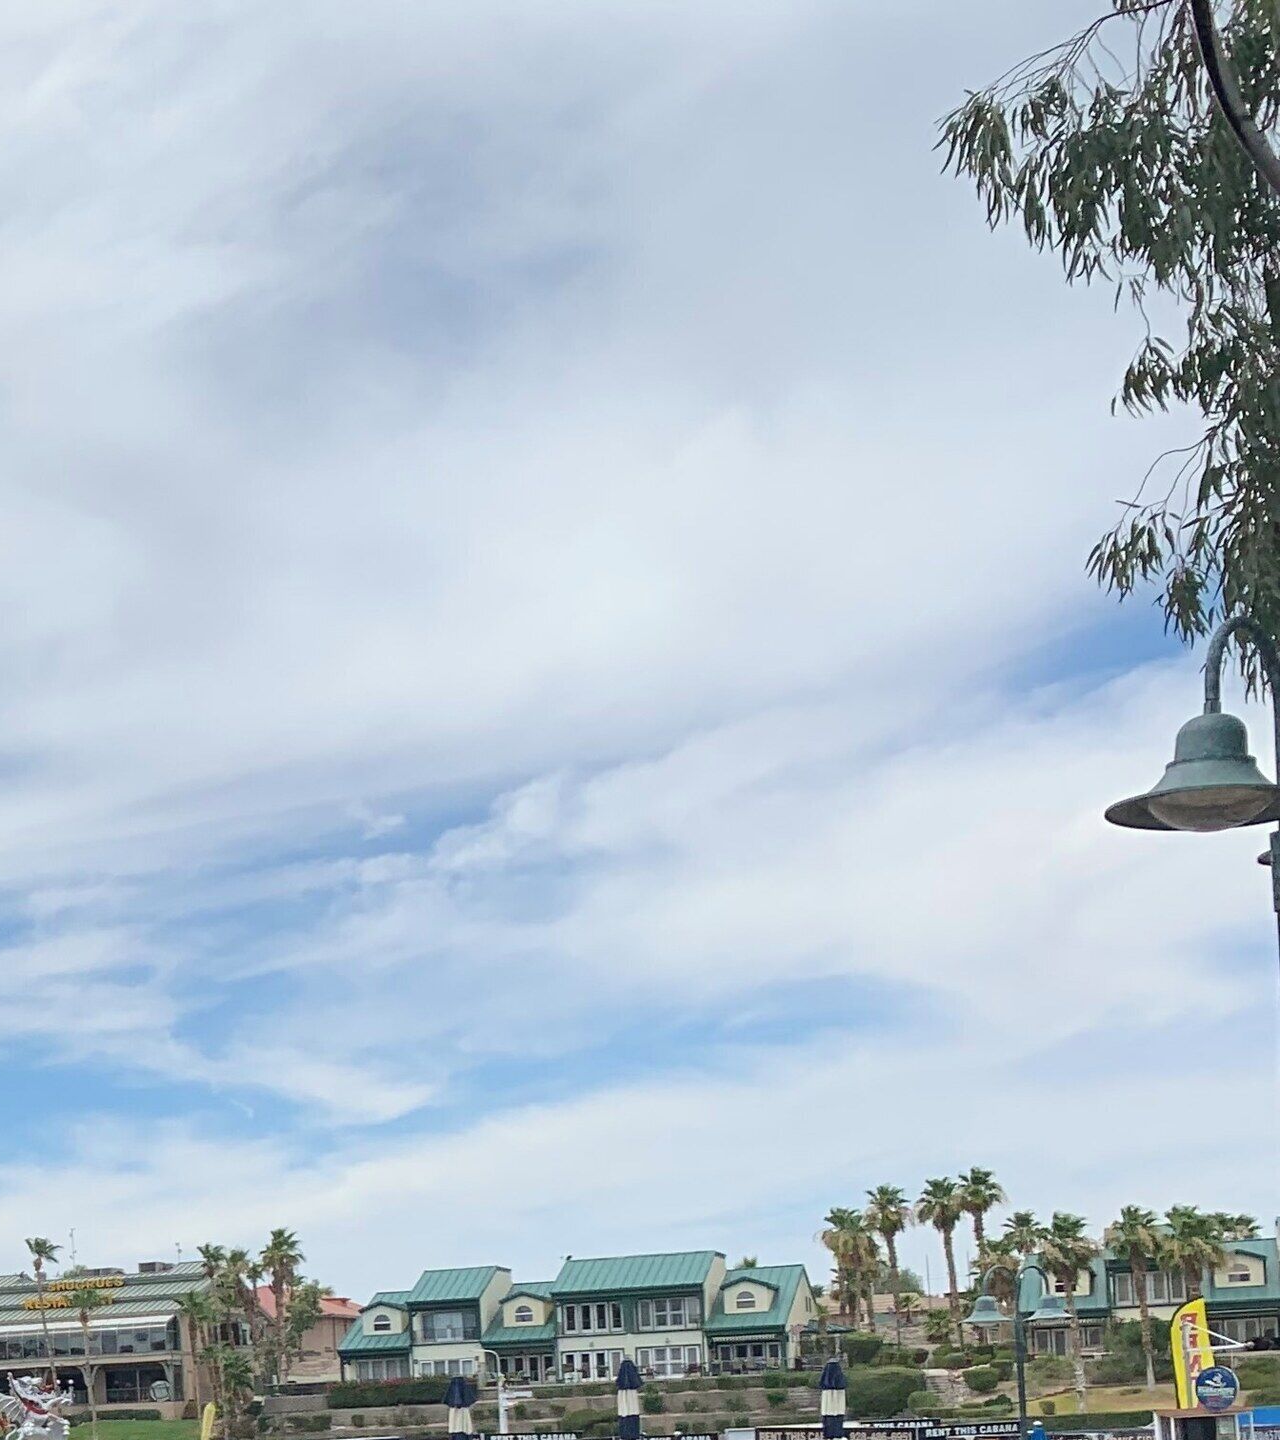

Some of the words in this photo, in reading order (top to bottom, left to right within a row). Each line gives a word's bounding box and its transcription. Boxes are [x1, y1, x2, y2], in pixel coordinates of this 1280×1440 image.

[925, 1428, 951, 1438] RENT
[955, 1426, 977, 1435] THIS
[979, 1423, 1018, 1434] CABANA
